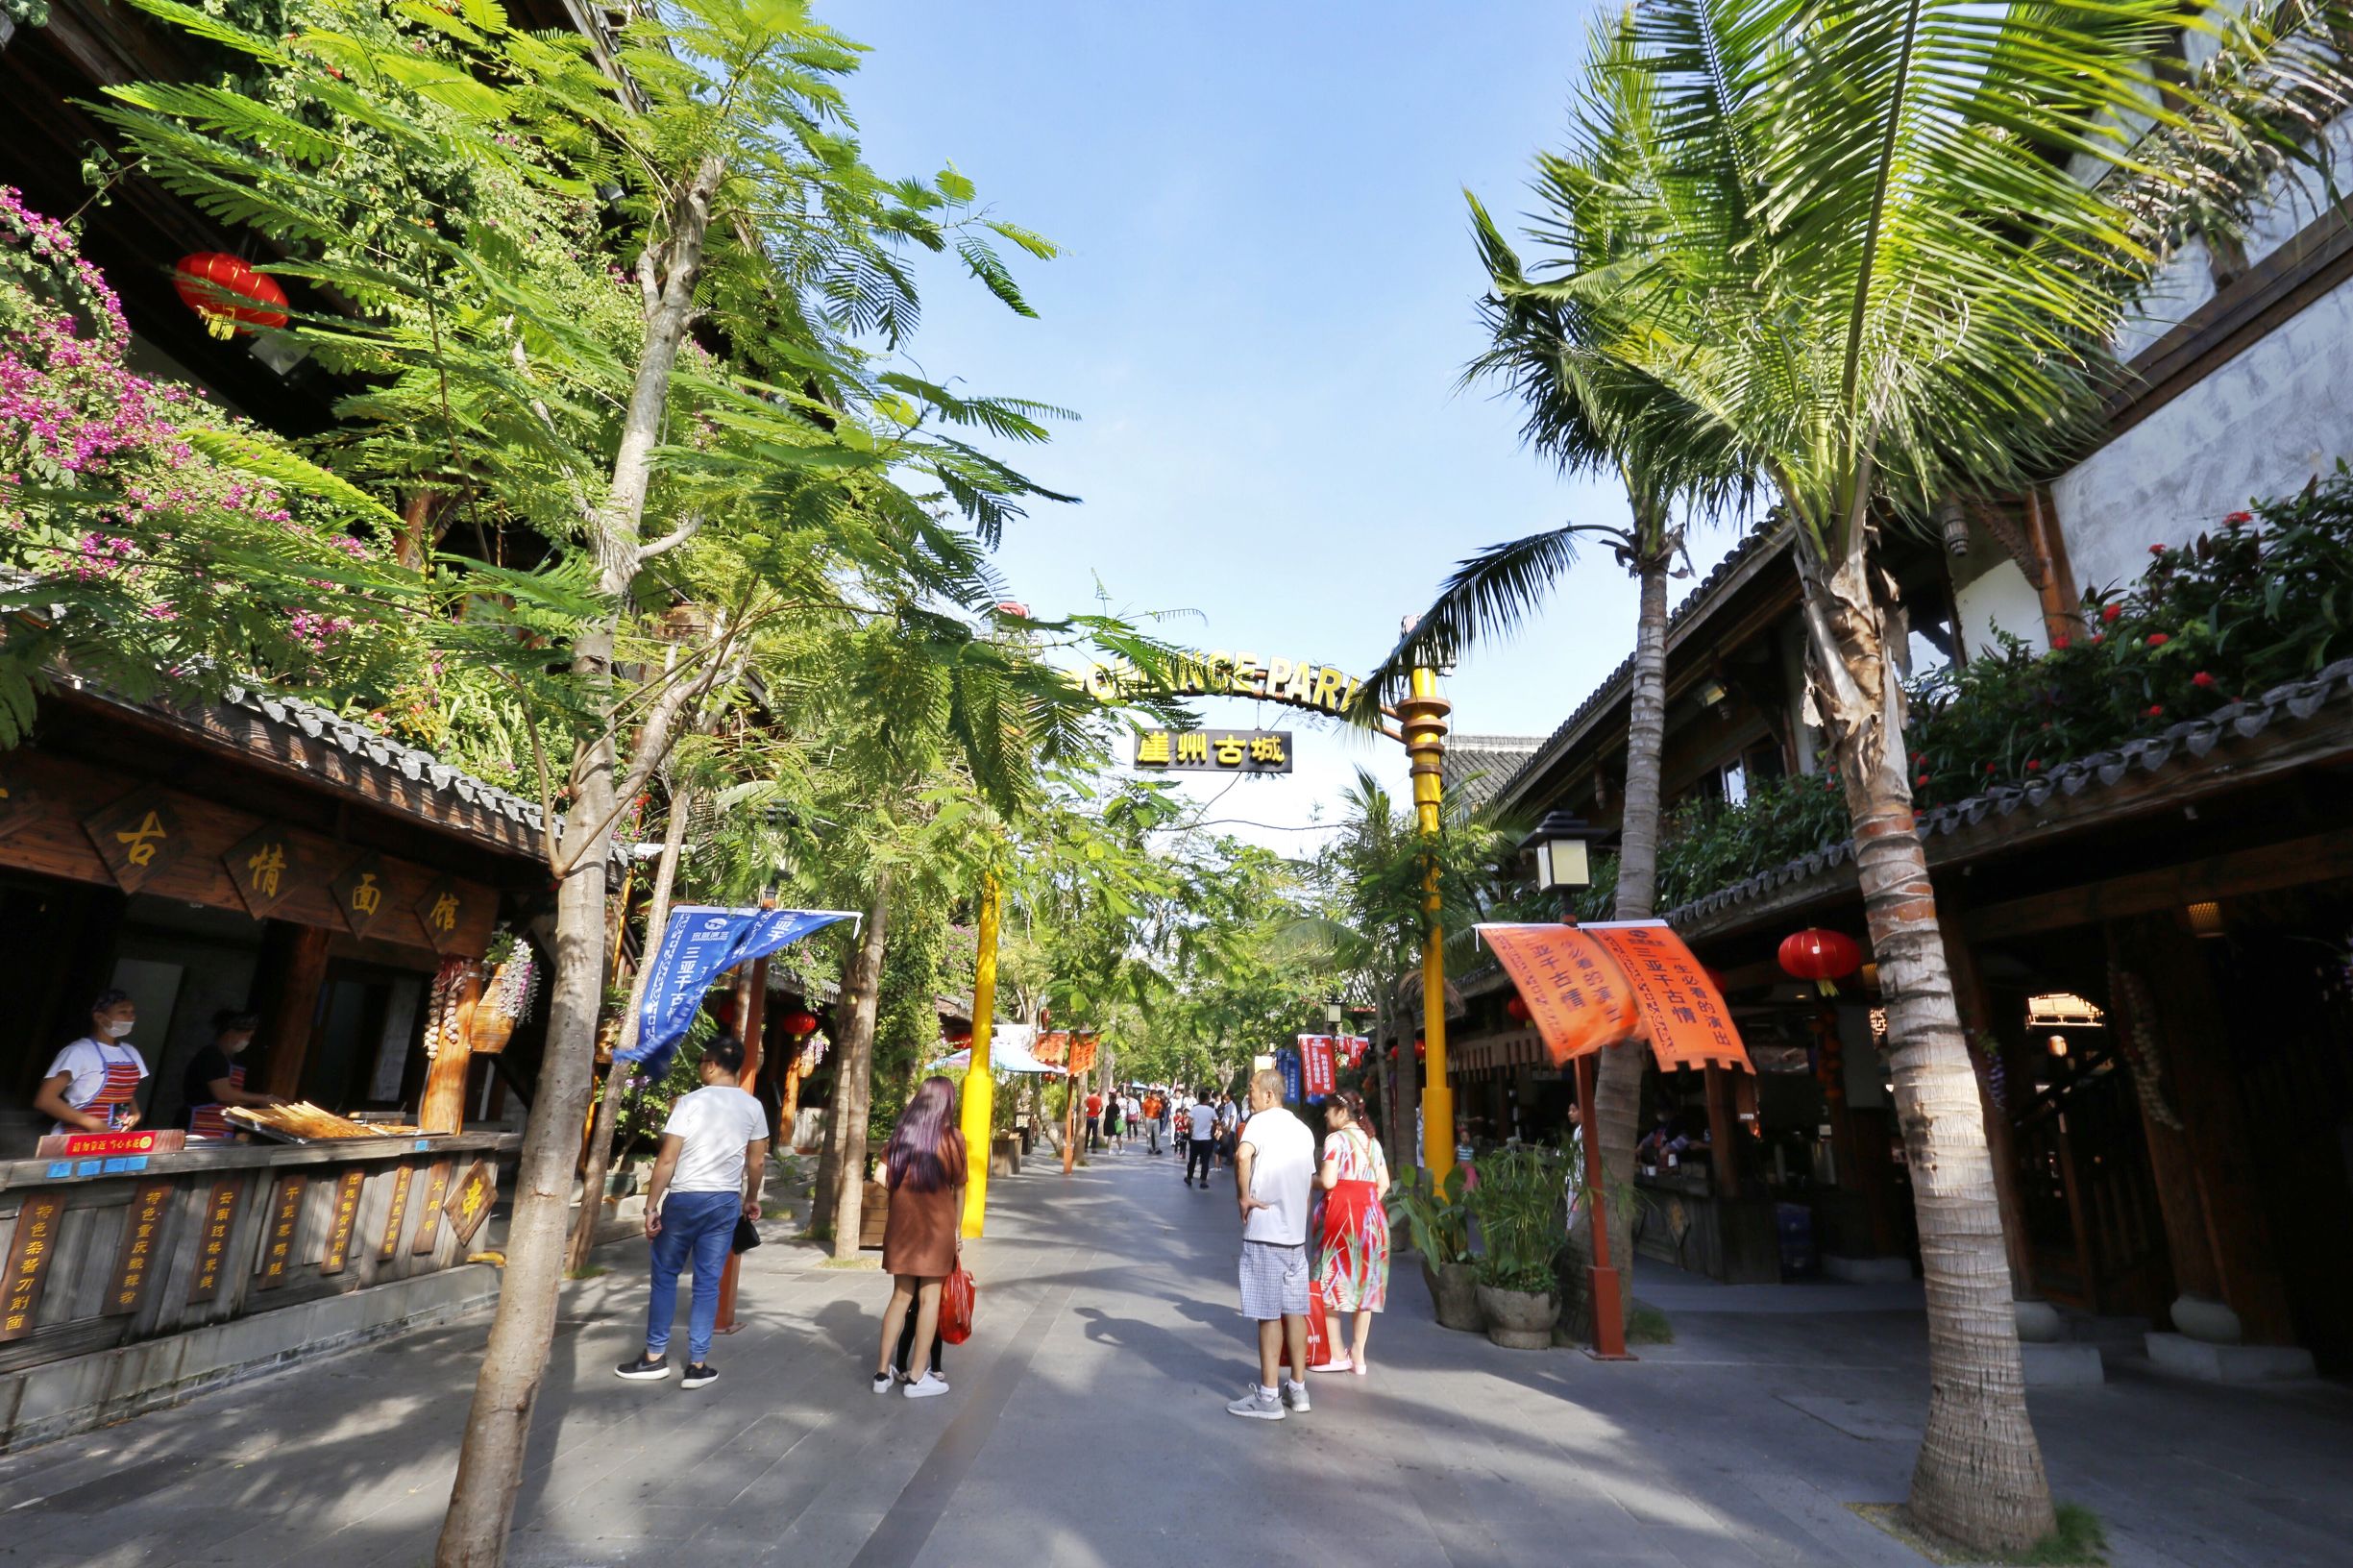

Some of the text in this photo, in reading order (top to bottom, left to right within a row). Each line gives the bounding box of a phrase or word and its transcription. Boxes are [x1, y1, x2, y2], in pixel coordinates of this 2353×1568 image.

[1137, 730, 1286, 765] 崖州古城
[1633, 947, 1698, 1024] 三亚千古情
[1666, 957, 1731, 1045] 一生必看的演出
